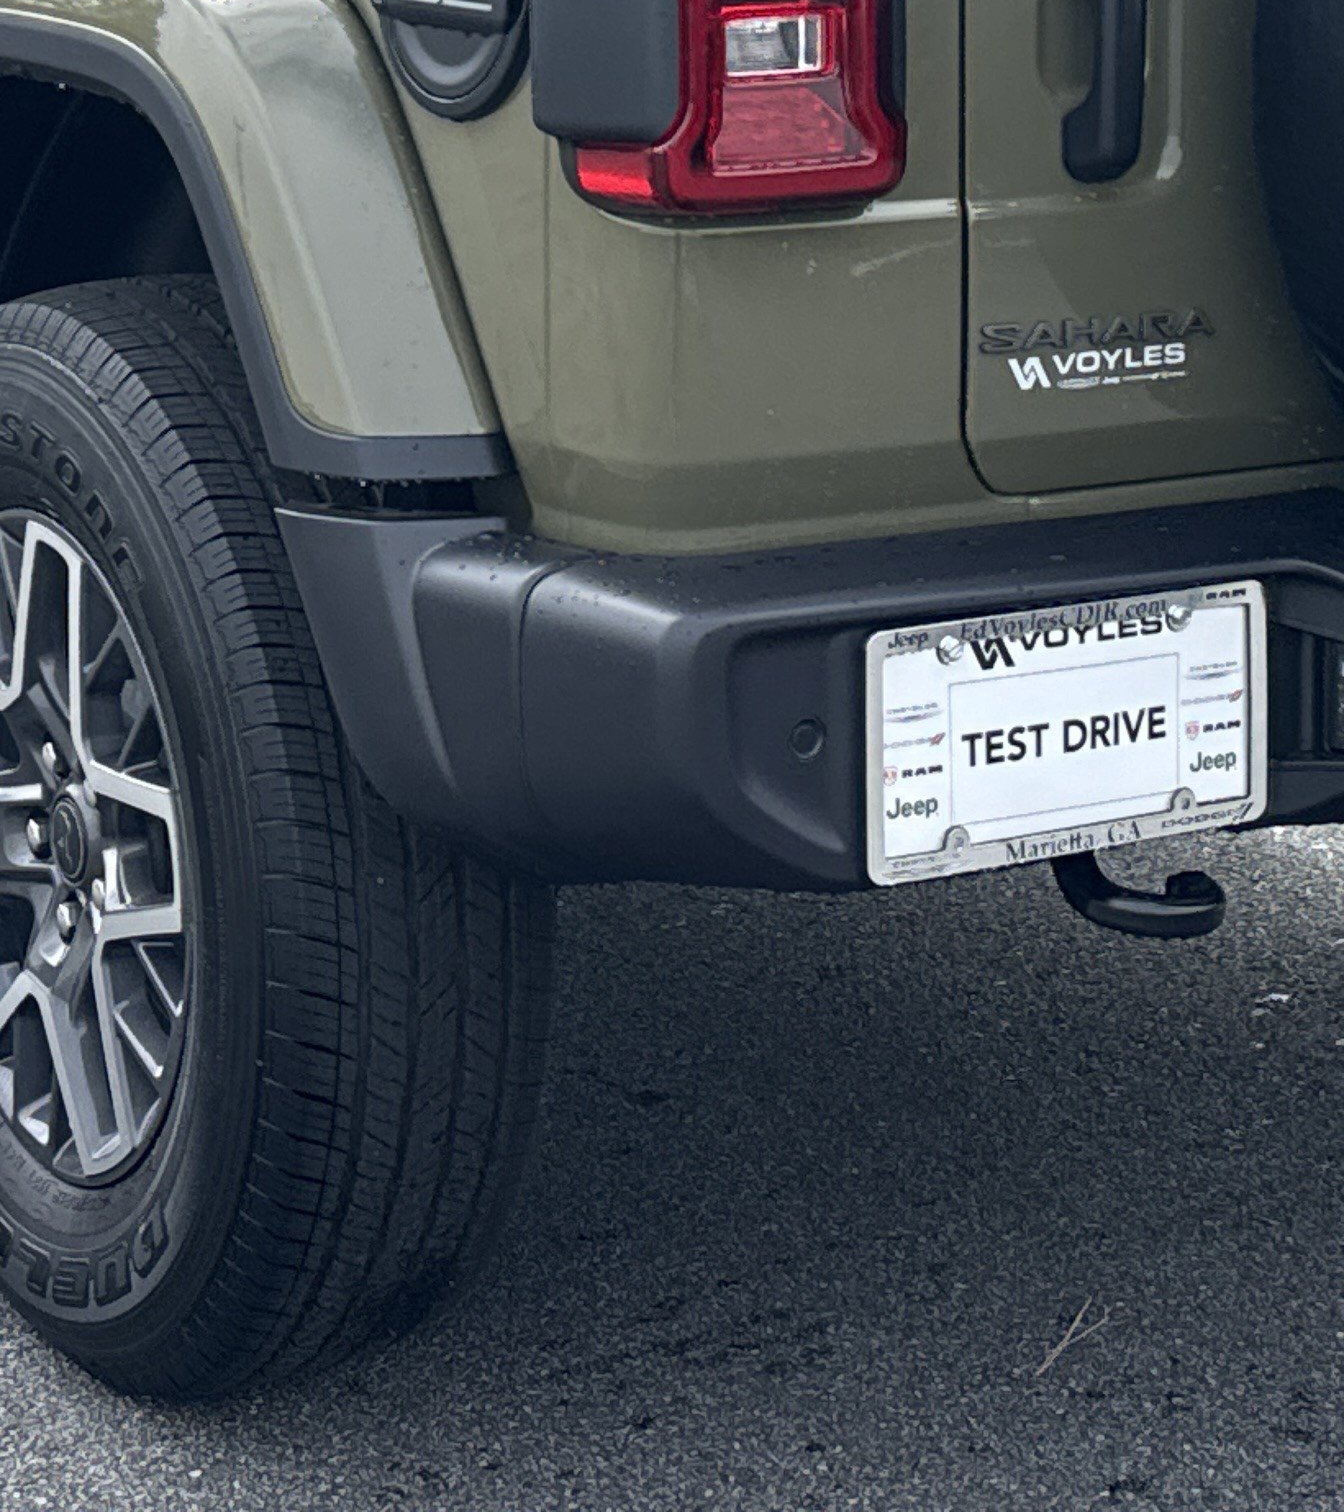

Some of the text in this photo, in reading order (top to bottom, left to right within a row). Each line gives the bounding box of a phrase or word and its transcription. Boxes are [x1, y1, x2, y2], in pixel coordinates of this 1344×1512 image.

[979, 307, 1216, 355] SAHARA
[1052, 342, 1186, 375] VOYLES
[962, 705, 1167, 767] TEST DRIVE
[1189, 751, 1237, 773] Jeep
[886, 797, 939, 819] Jeep
[1107, 820, 1143, 844] GA
